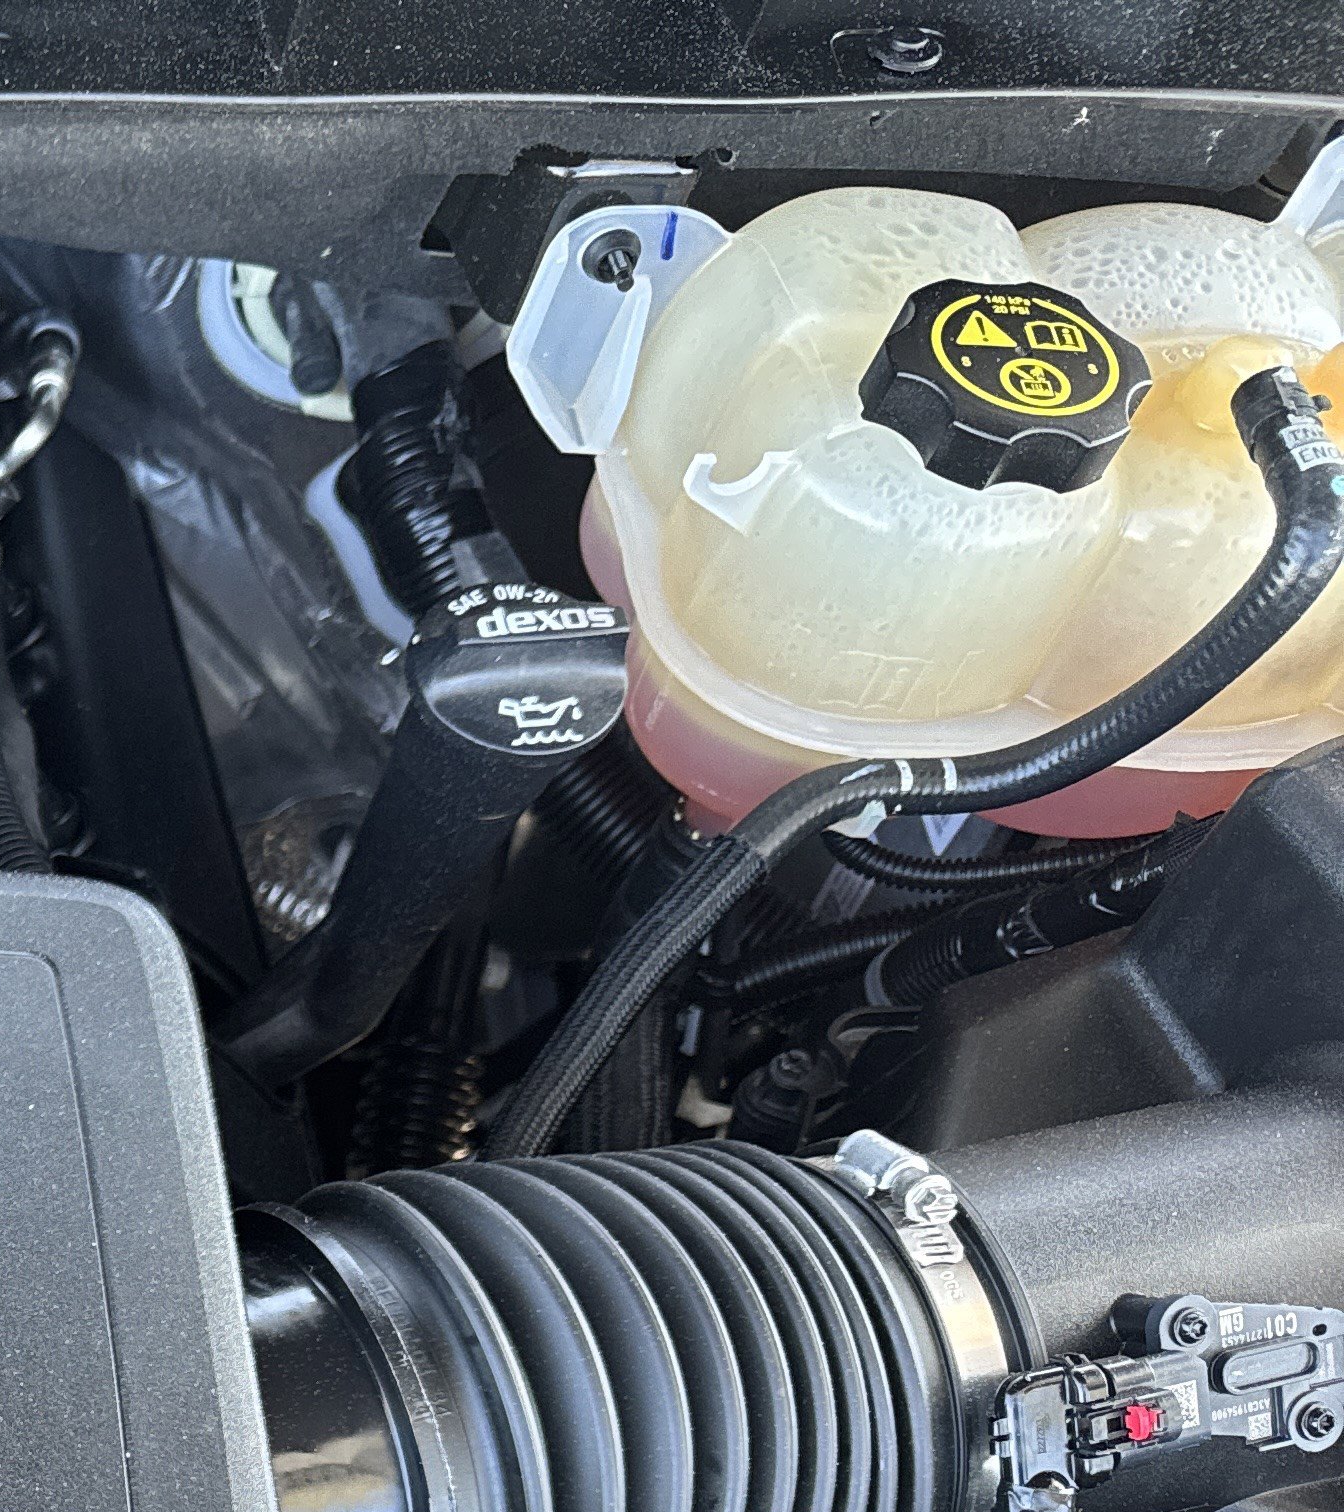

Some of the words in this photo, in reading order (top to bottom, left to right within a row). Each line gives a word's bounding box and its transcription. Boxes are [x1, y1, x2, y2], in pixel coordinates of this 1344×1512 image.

[992, 305, 1008, 314] 20
[447, 588, 488, 616] SAE
[476, 607, 615, 638] dexos
[1219, 1312, 1244, 1336] GM
[1266, 1312, 1298, 1340] C01
